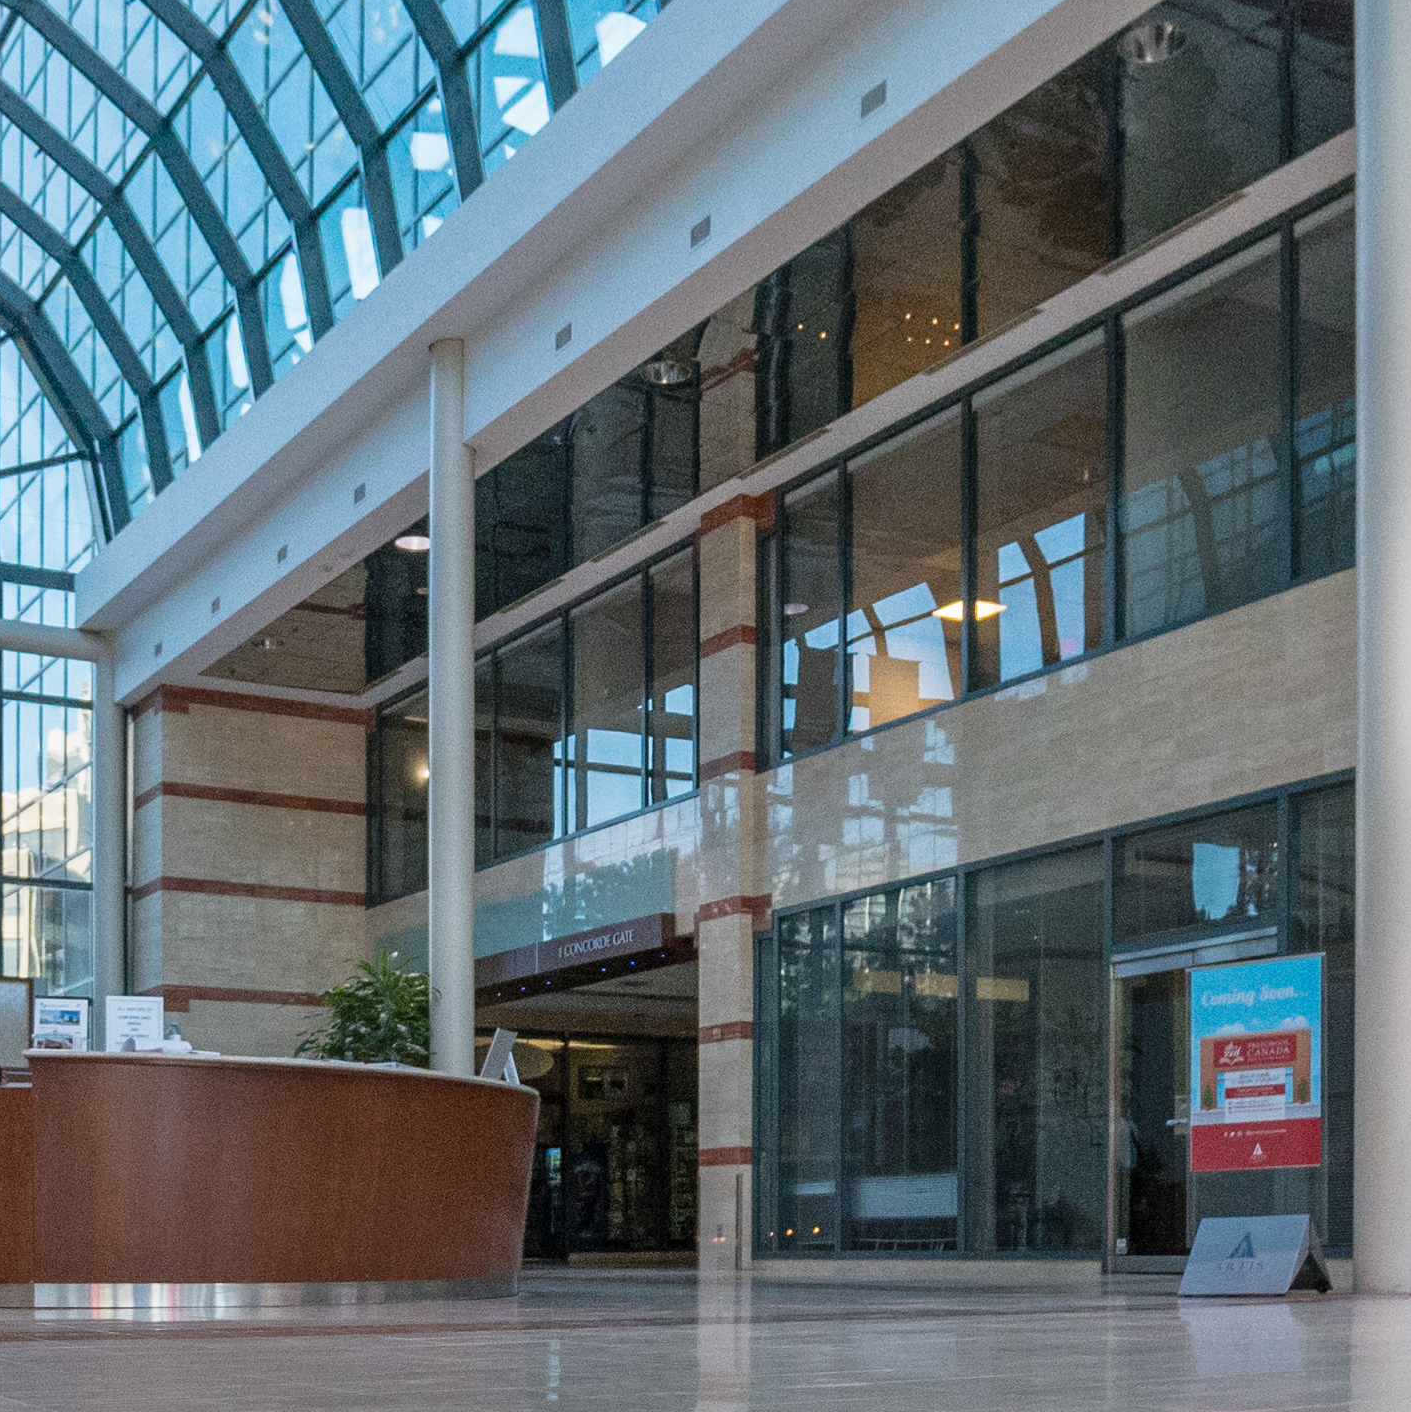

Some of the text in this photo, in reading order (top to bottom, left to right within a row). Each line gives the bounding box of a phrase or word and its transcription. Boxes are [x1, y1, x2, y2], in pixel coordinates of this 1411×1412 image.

[564, 934, 612, 957] CONCORDE
[612, 929, 635, 946] GATE
[1201, 989, 1256, 1008] Coming
[1247, 1047, 1290, 1057] CANADA
